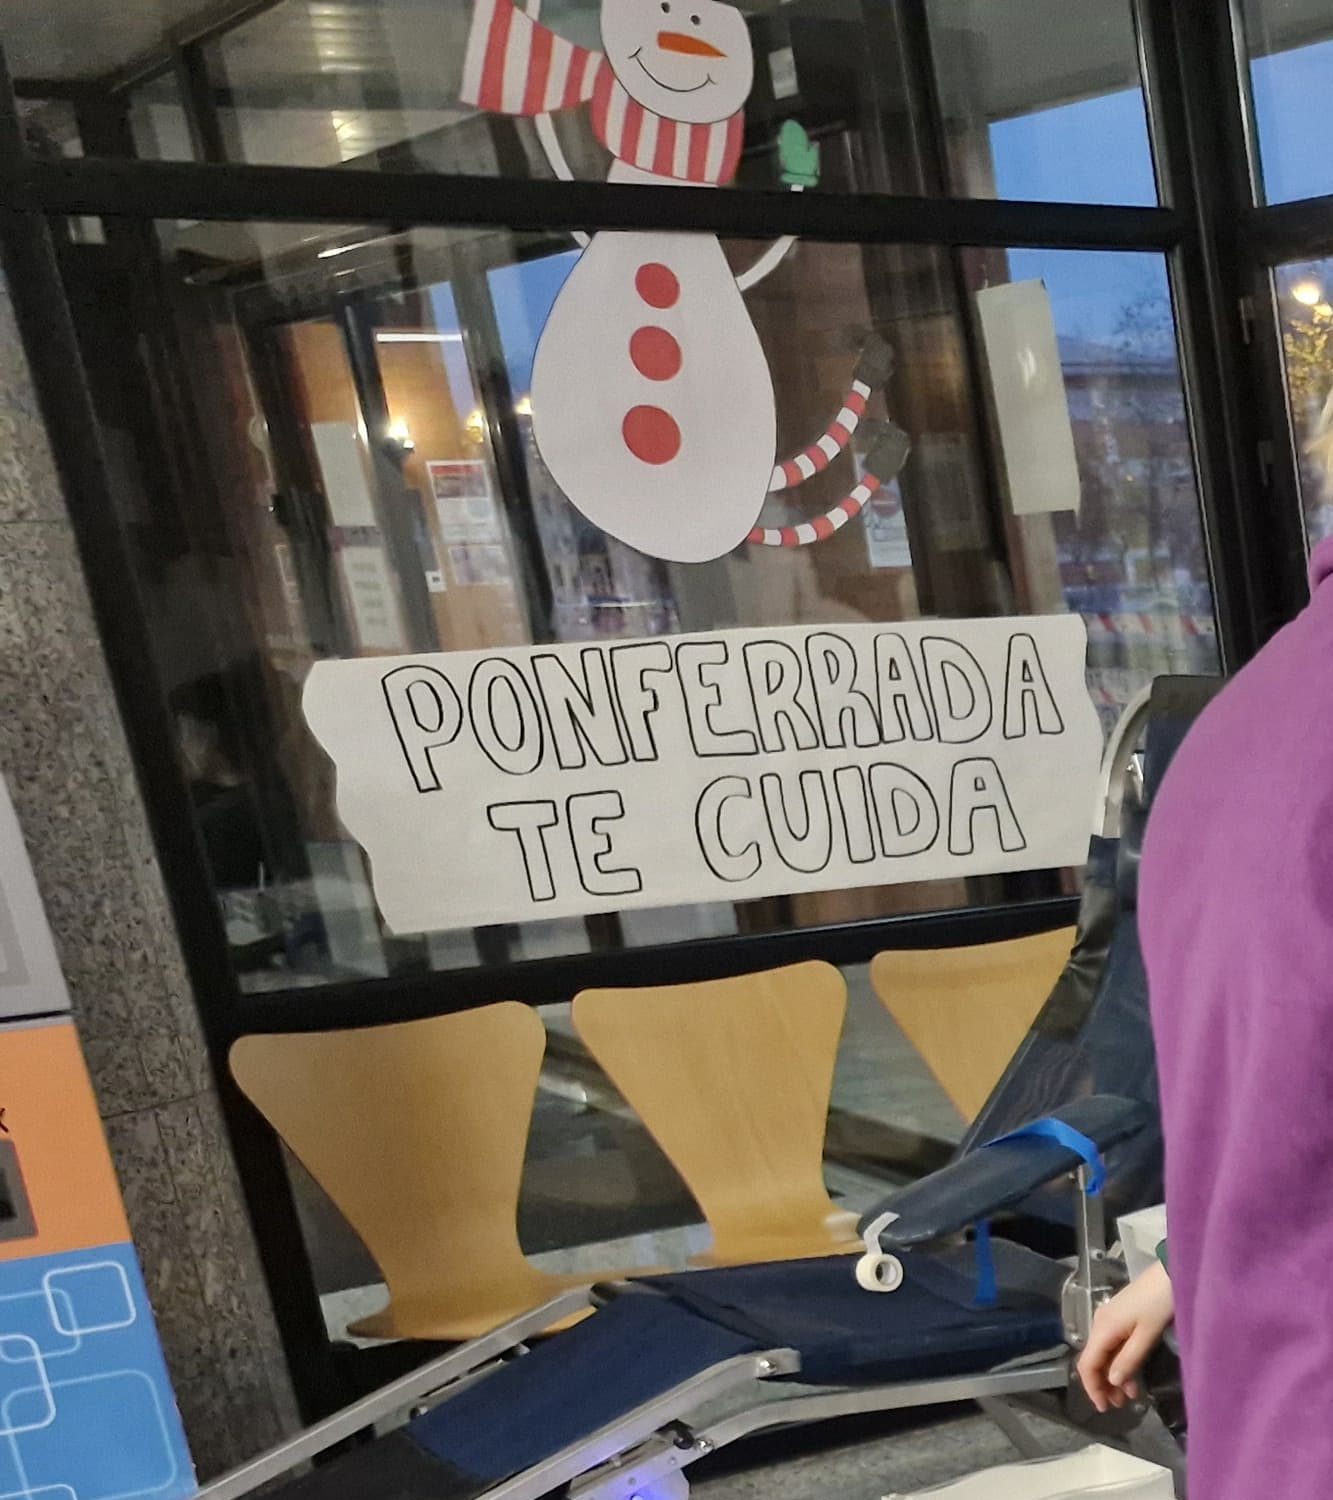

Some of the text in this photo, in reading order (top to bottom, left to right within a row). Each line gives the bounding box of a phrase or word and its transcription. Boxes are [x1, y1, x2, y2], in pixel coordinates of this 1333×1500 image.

[381, 631, 1065, 793] PONFERRADA
[486, 757, 1027, 902] TE CUIDA
